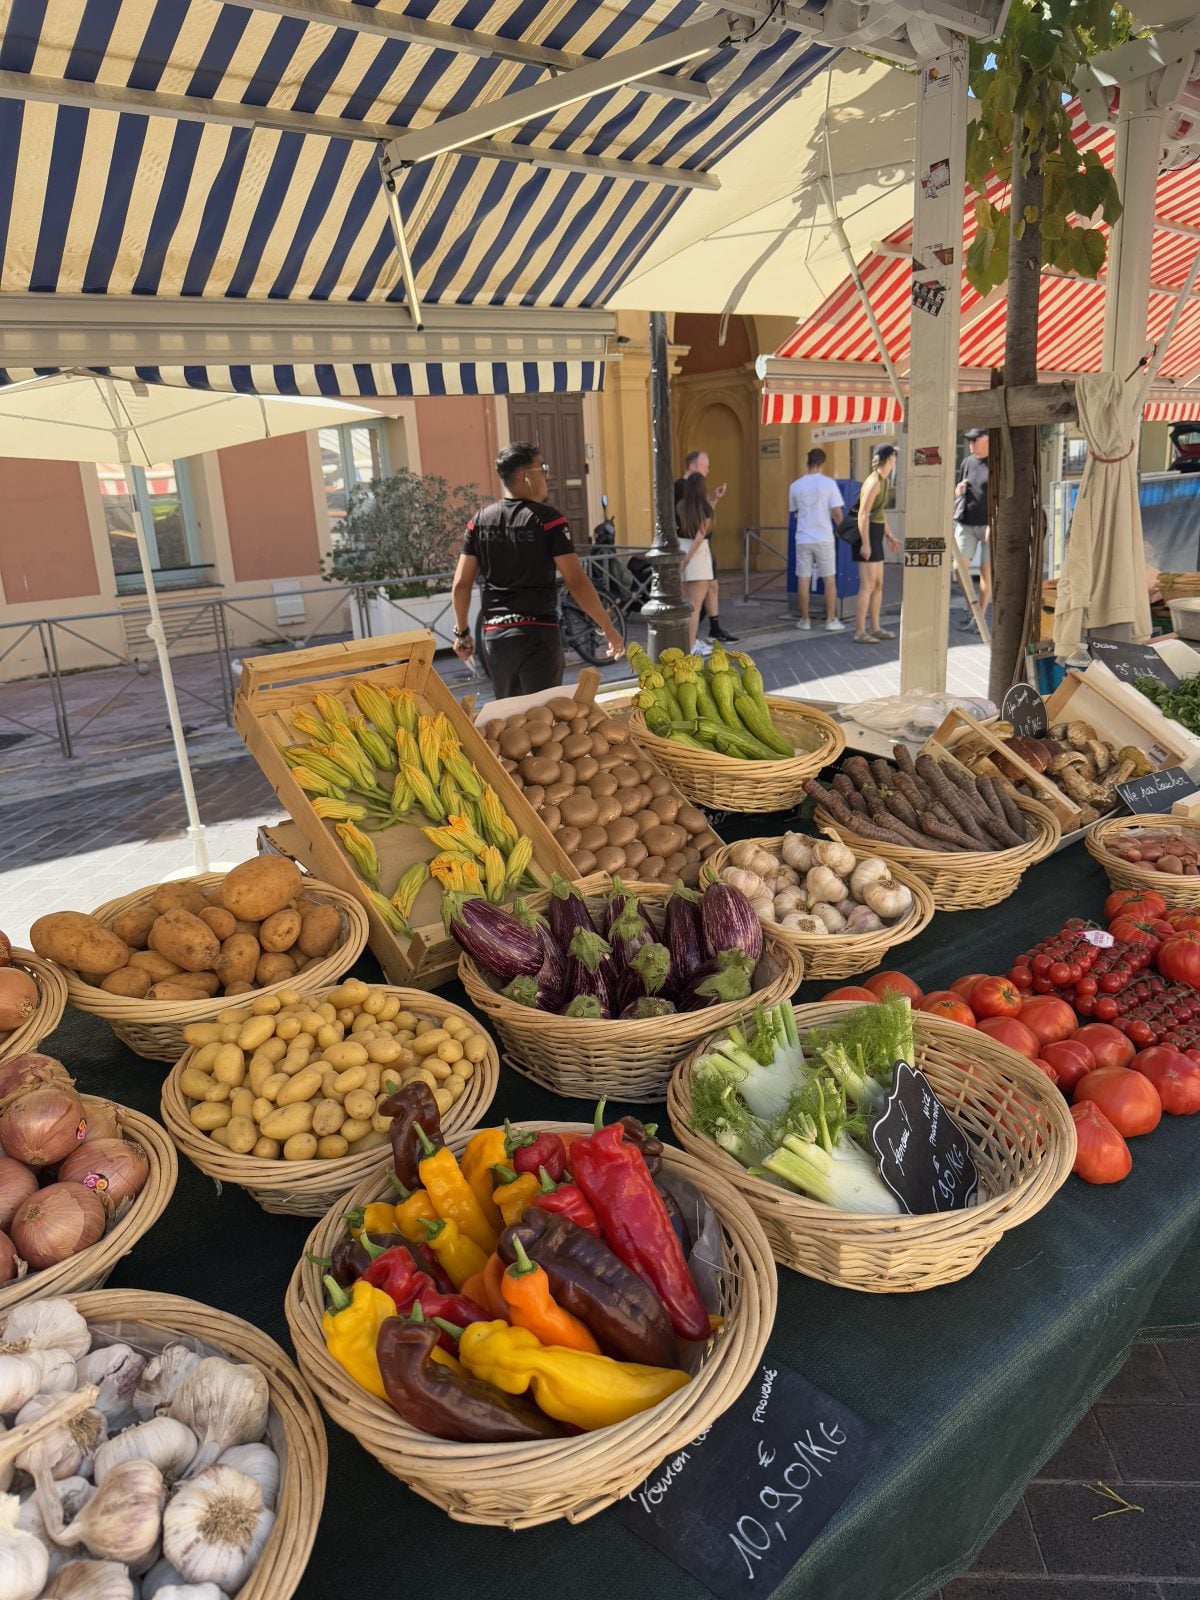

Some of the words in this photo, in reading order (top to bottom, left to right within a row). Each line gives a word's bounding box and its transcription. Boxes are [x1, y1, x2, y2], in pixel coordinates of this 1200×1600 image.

[1123, 784, 1139, 803] Ne
[1140, 786, 1157, 807] pas
[1152, 771, 1189, 791] toucher
